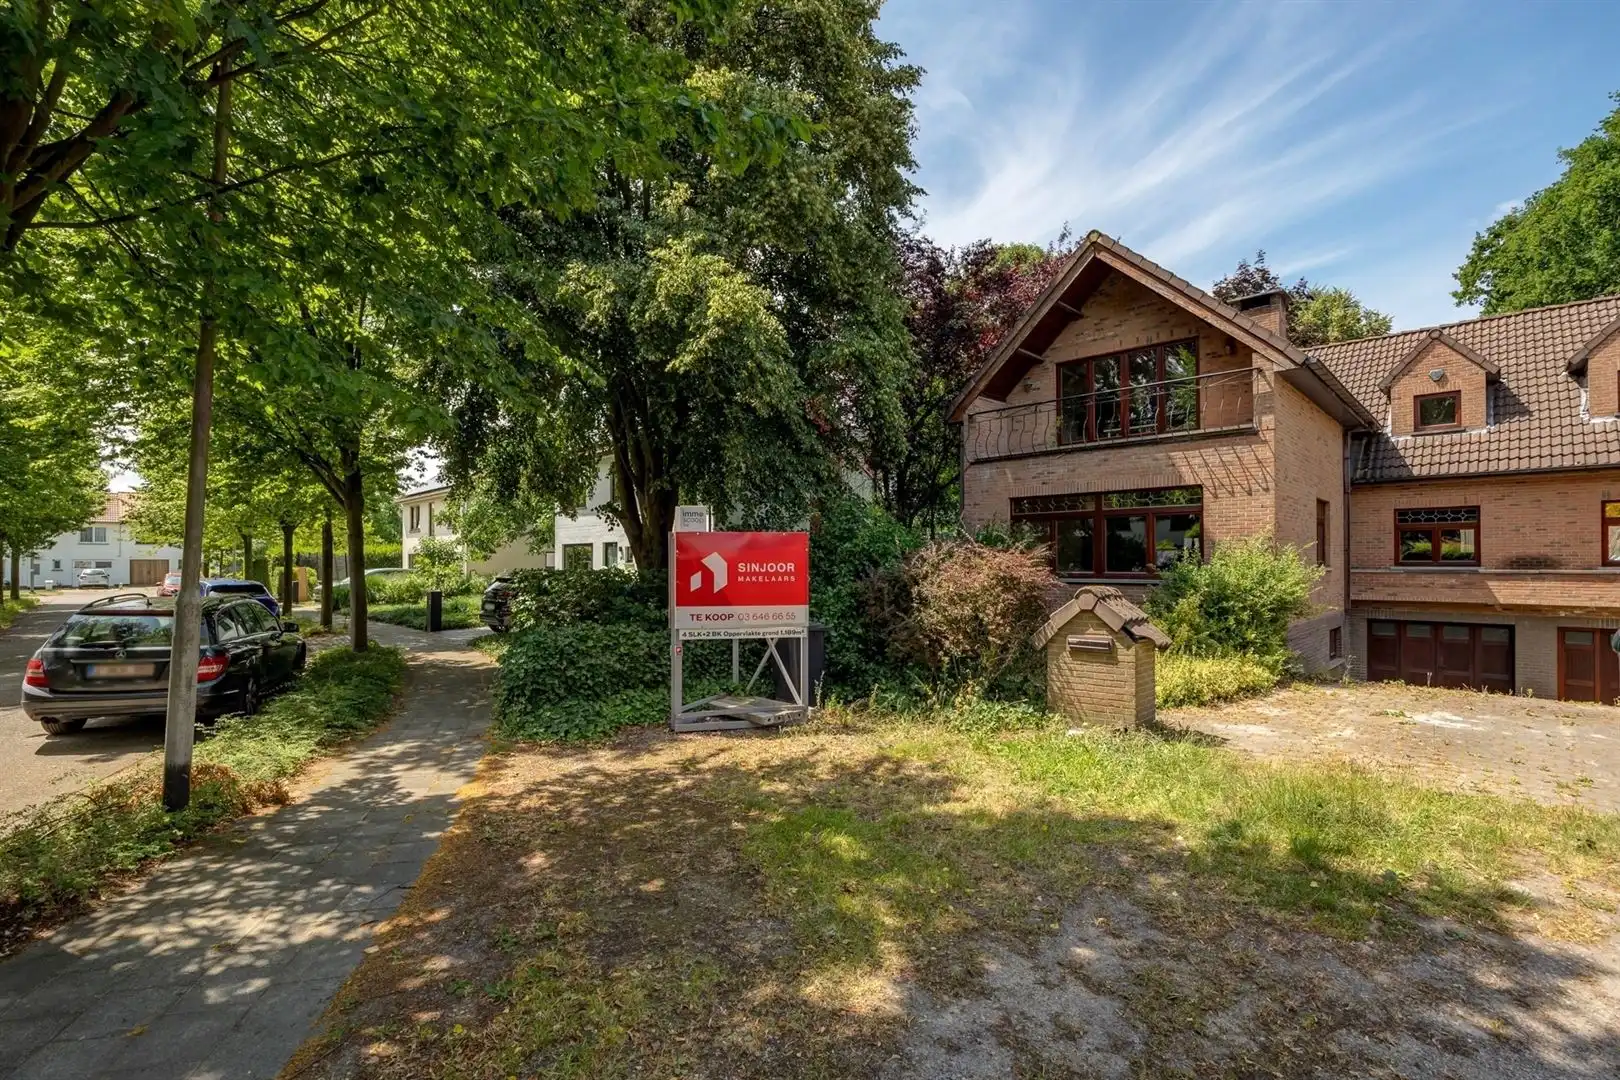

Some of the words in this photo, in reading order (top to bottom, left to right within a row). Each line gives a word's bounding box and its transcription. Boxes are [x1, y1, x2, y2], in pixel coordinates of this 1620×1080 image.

[738, 562, 795, 572] SINJOOR
[772, 612, 784, 620] 66
[786, 612, 796, 620] 55
